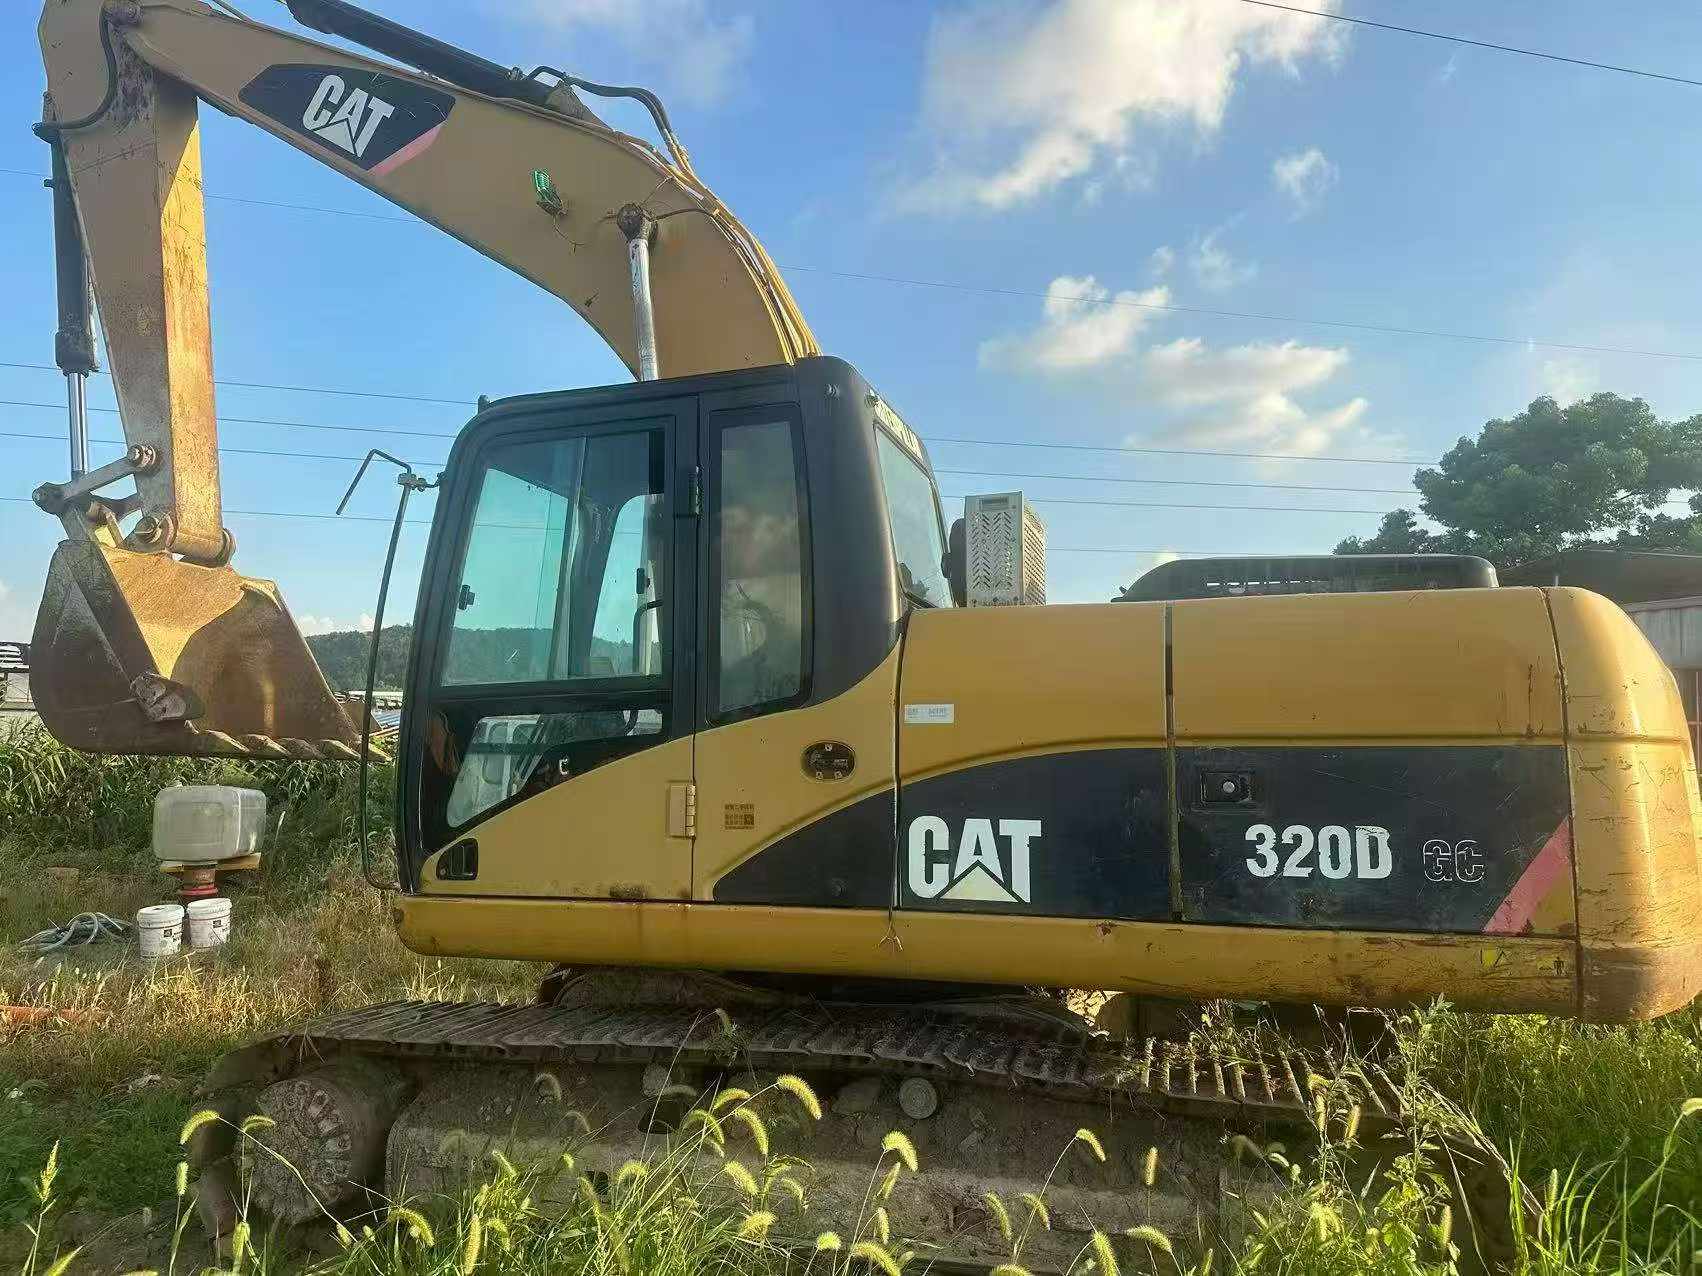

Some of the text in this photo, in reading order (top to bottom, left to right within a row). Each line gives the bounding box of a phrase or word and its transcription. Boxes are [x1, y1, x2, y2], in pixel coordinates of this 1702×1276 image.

[303, 74, 395, 157] CAT
[908, 815, 1042, 902] CAT
[1245, 823, 1393, 879] 320D
